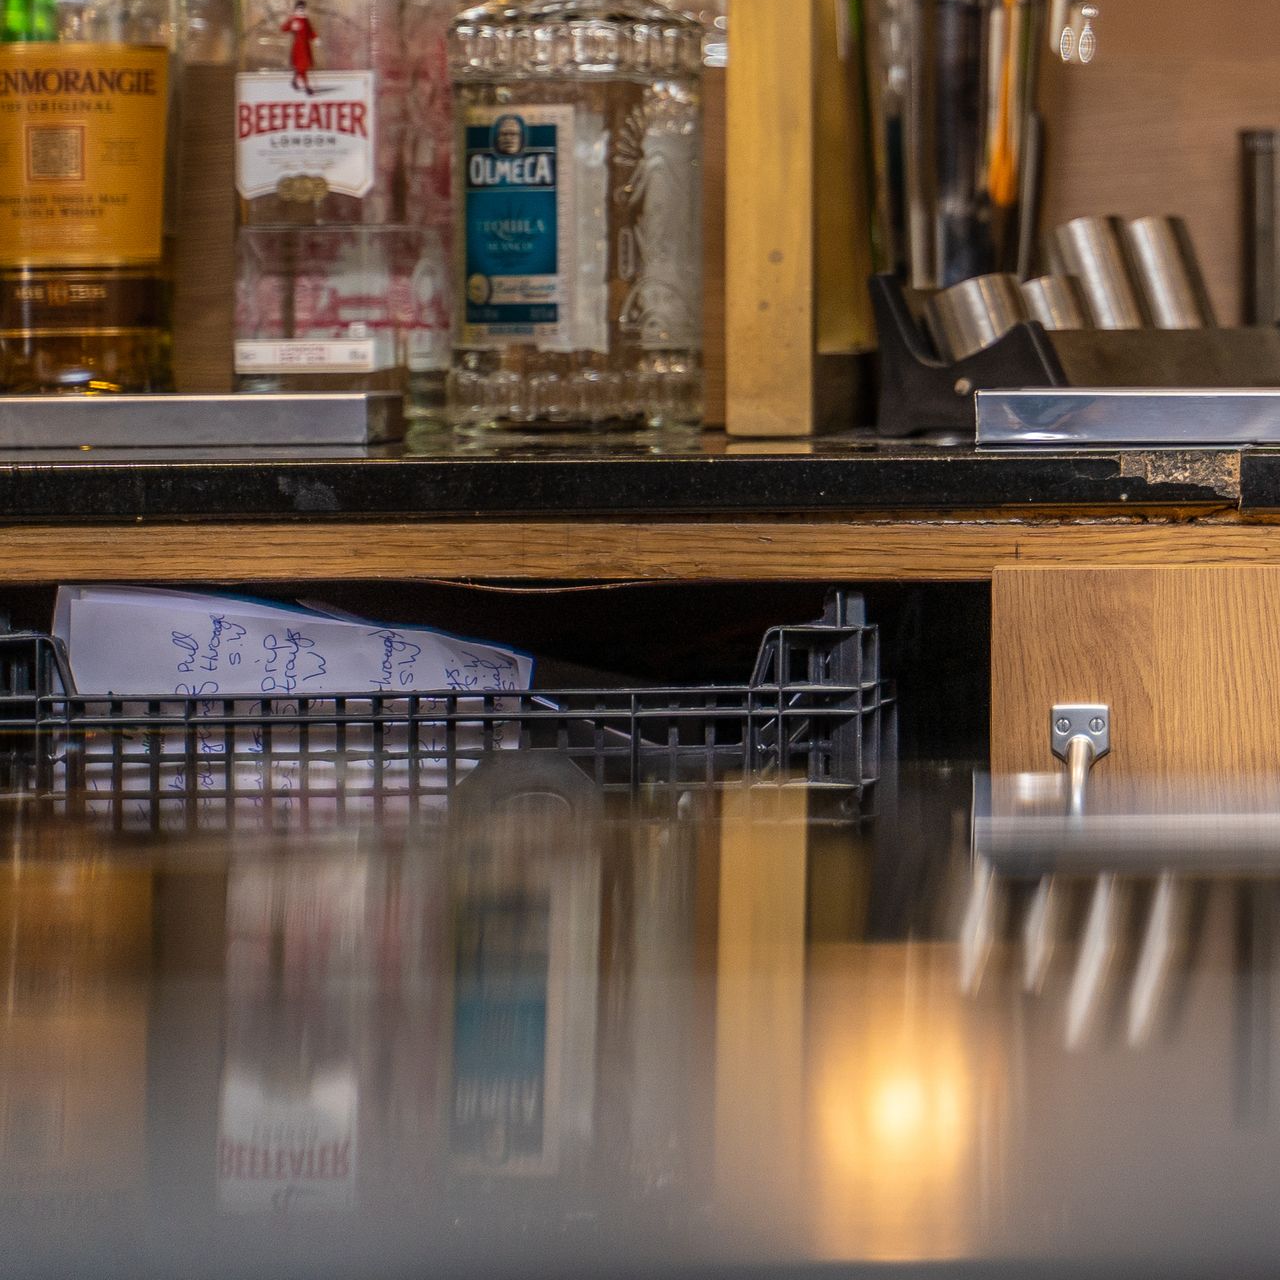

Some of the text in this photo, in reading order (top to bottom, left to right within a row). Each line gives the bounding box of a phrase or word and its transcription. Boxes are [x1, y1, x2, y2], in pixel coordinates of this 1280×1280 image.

[0, 67, 158, 96] NMORANGIE
[237, 100, 369, 140] BEEFEATER
[469, 153, 552, 186] OLMECA
